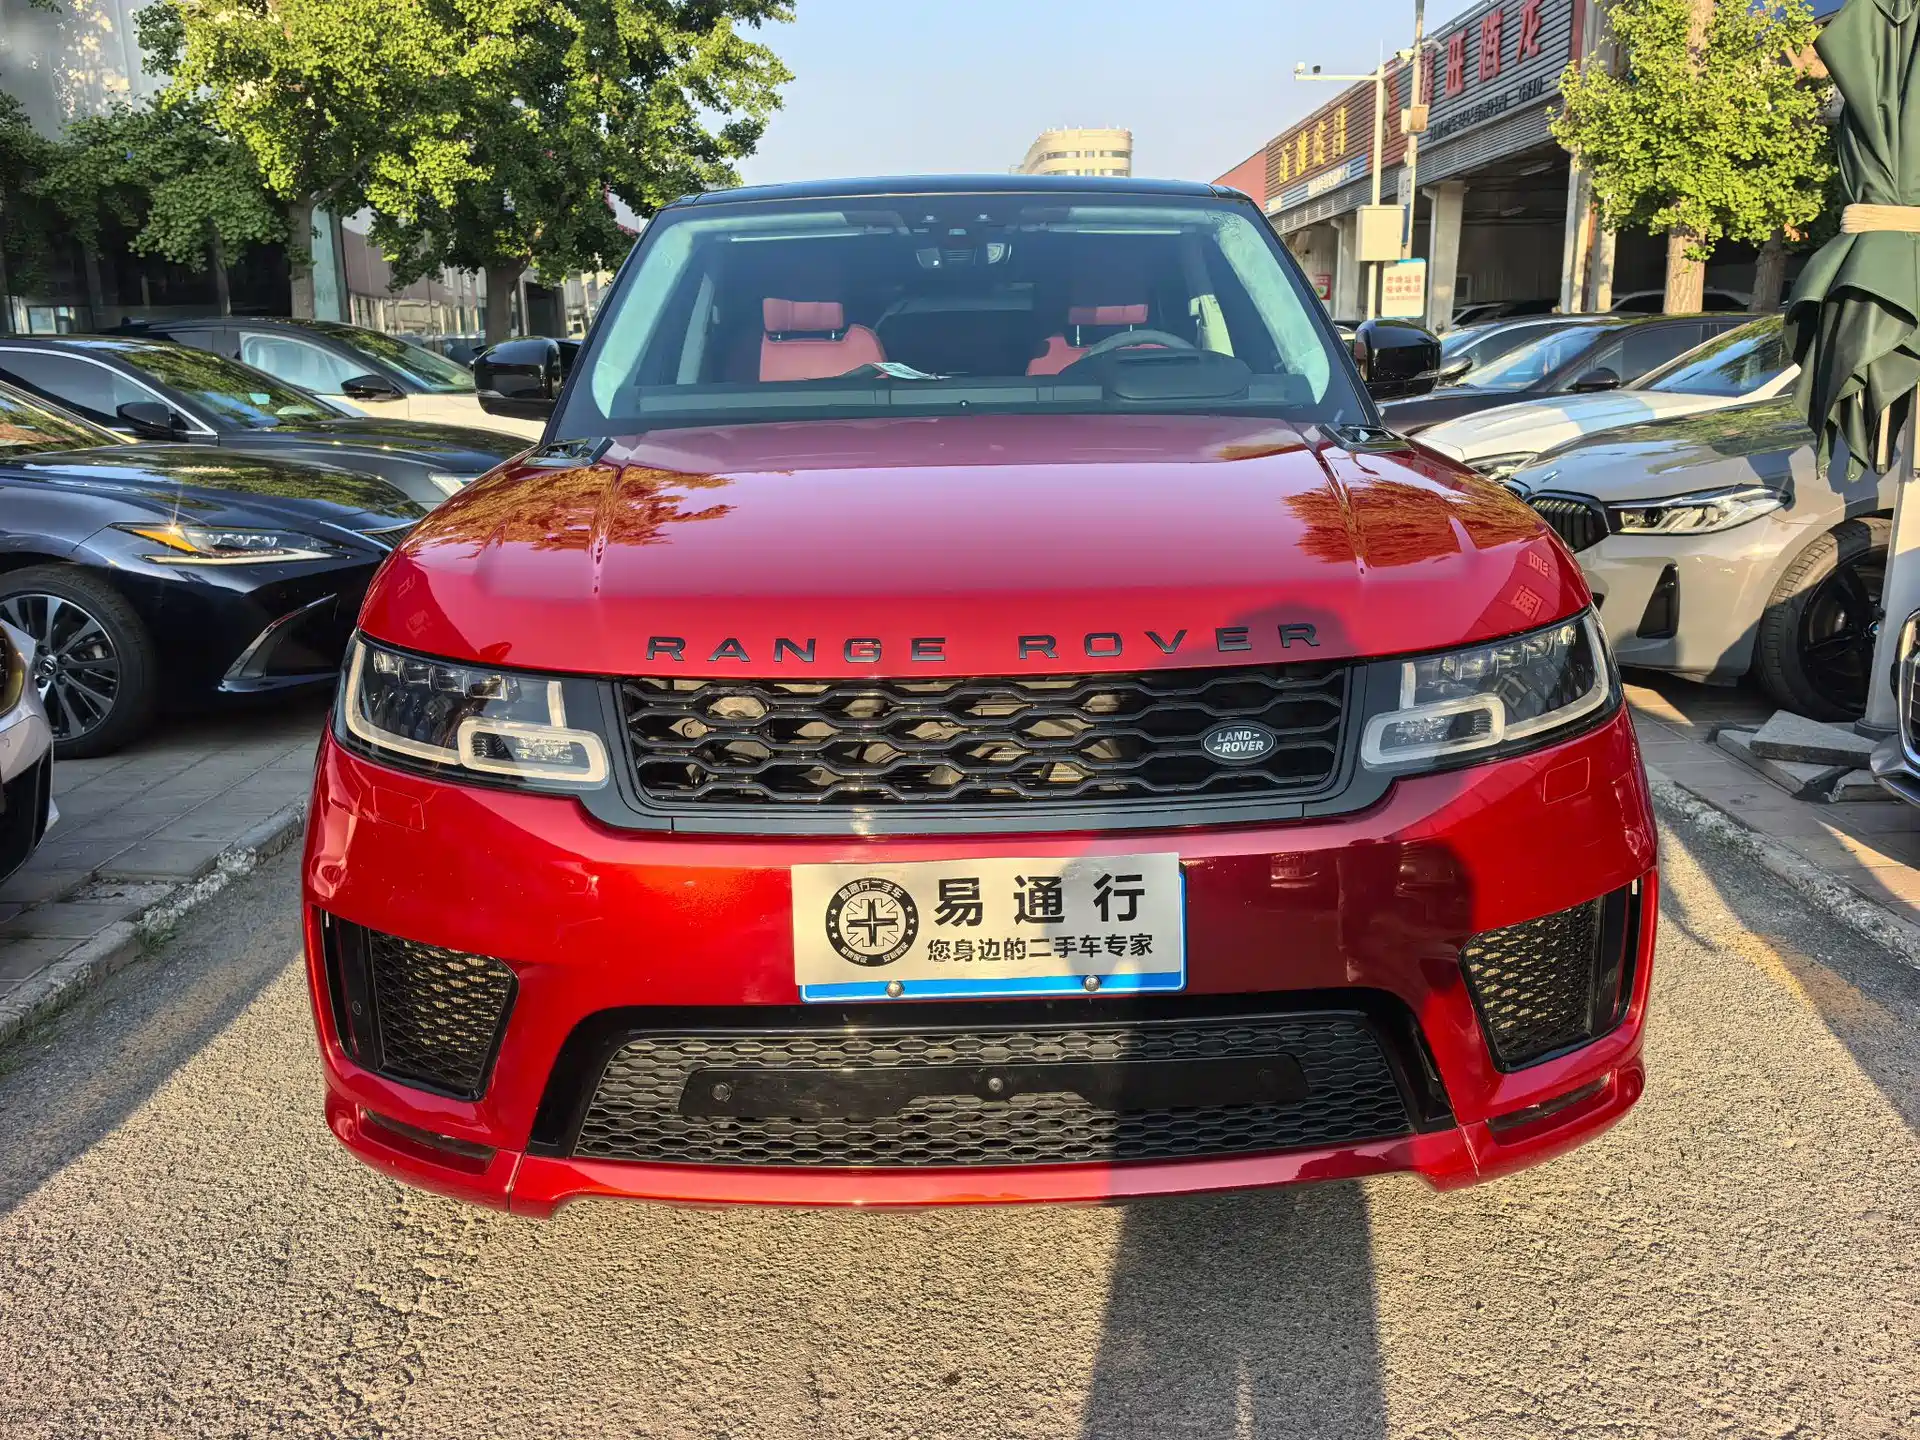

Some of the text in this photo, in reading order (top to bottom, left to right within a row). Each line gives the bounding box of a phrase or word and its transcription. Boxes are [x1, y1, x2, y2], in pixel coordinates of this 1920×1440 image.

[646, 621, 1321, 663] RANGE ROVER
[837, 880, 905, 902] 易通行二手车
[933, 872, 1147, 928] 易通行
[927, 932, 1154, 964] 您身边的二手车专家
